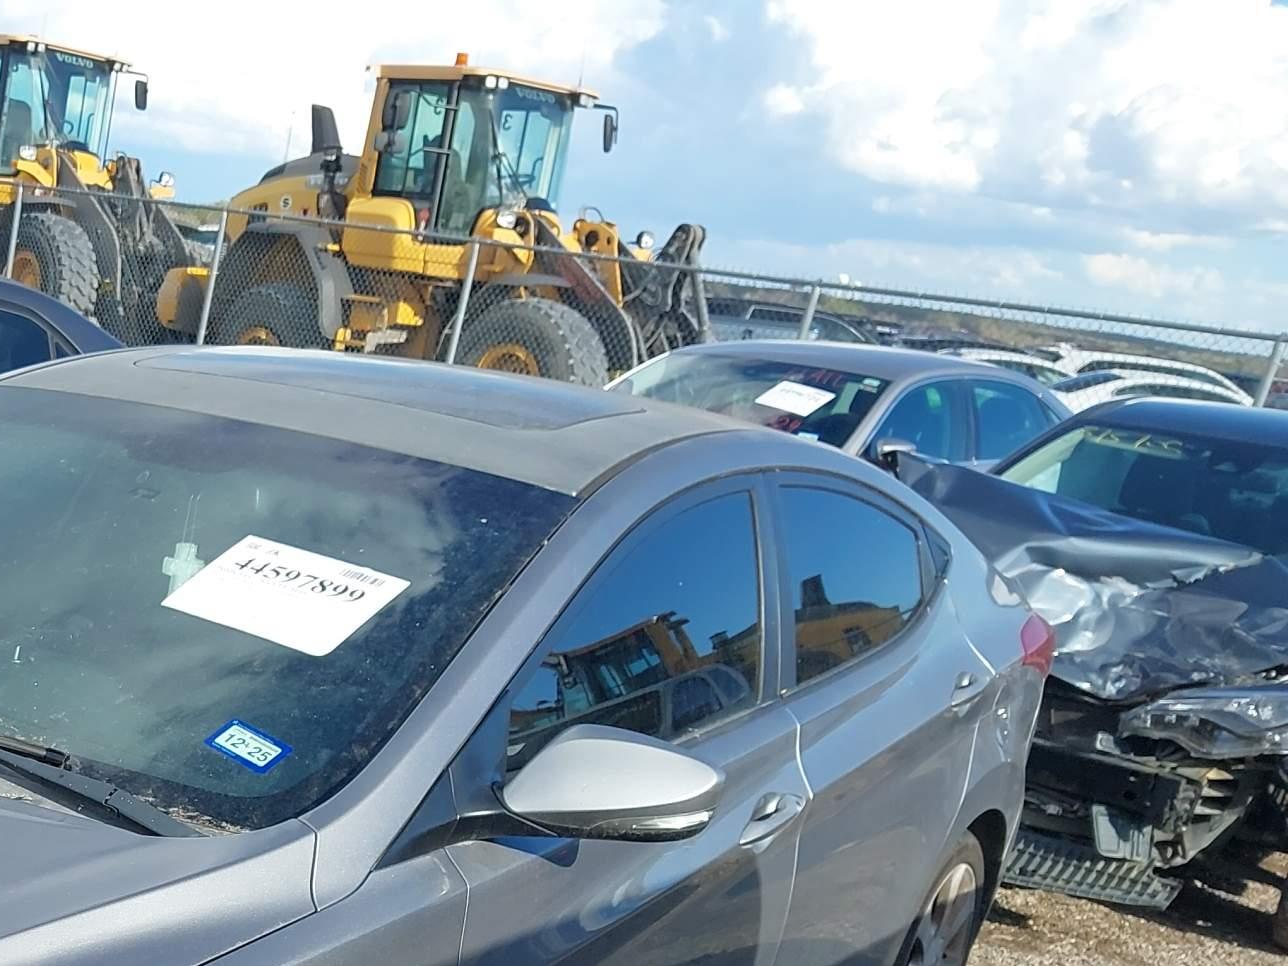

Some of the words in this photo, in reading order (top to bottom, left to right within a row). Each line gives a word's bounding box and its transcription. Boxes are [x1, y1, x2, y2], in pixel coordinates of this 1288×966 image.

[56, 52, 94, 69] VOLVO
[516, 88, 556, 103] VOLVO
[235, 558, 366, 602] 44597899
